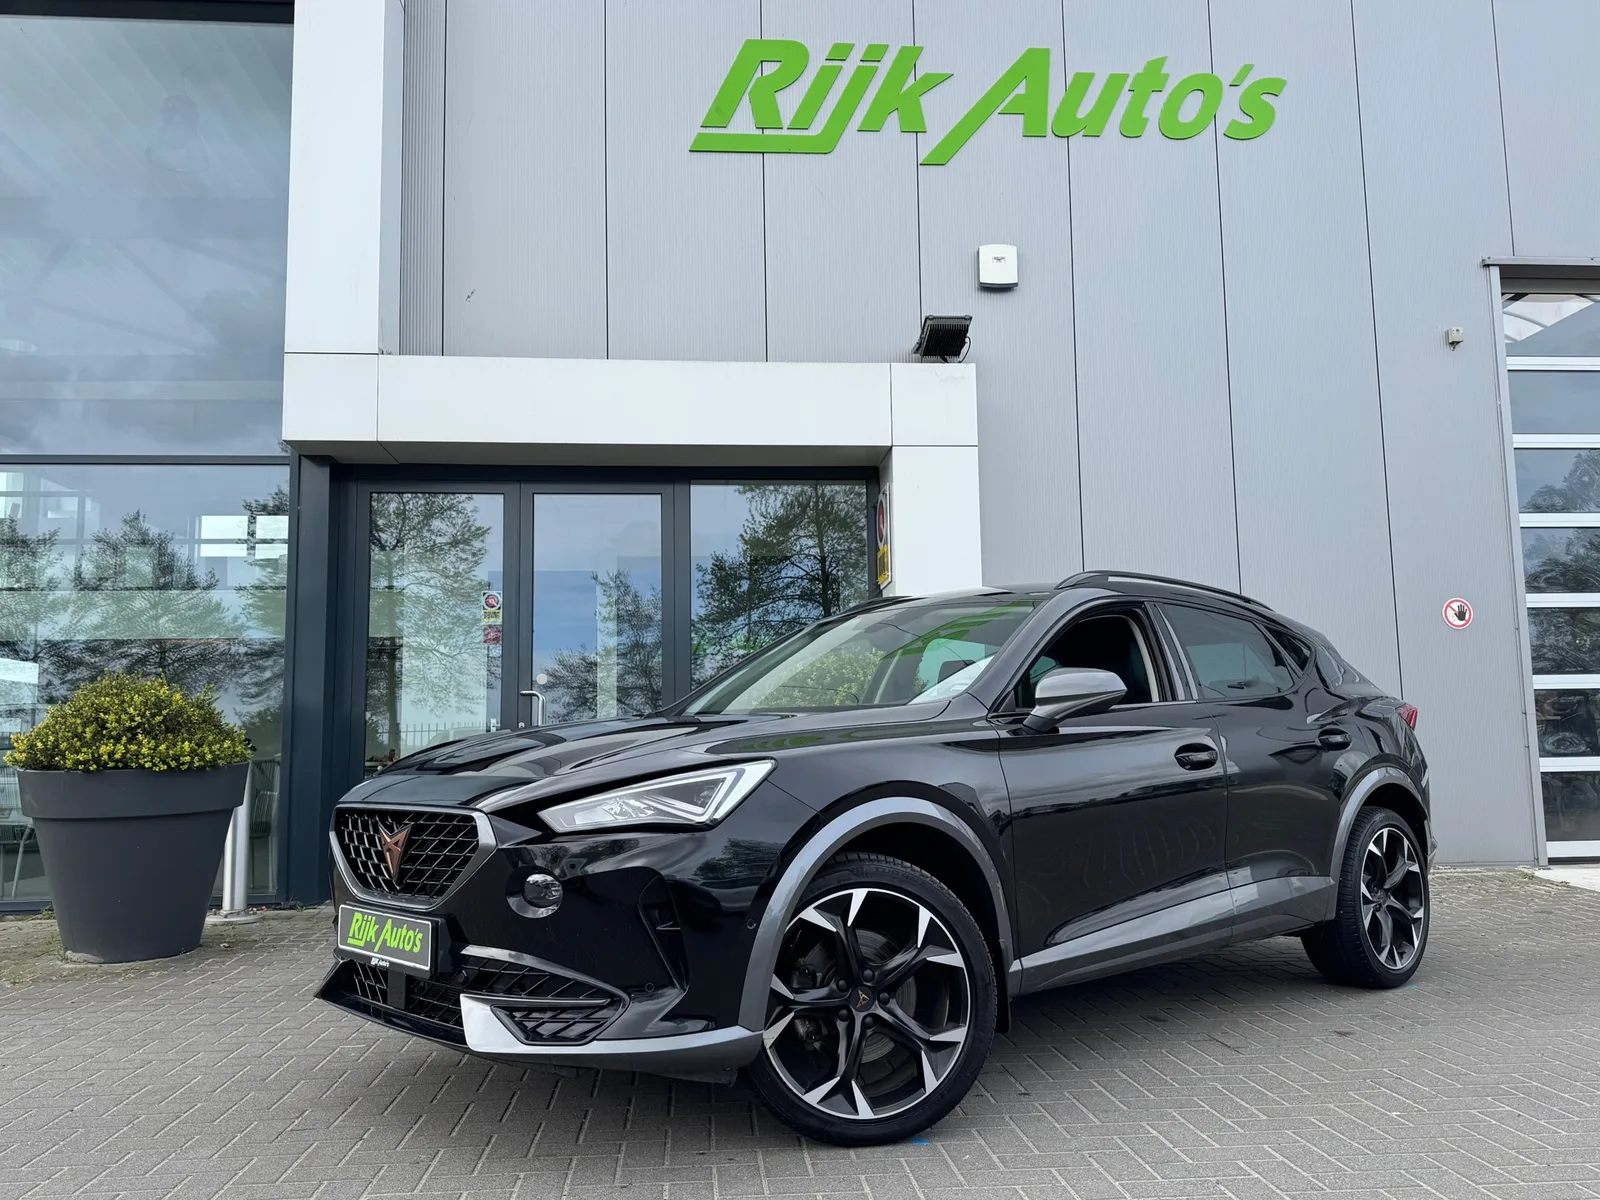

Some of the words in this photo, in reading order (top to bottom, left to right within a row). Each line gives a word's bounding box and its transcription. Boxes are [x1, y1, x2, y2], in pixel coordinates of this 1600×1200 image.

[689, 39, 952, 154] Rijk
[919, 47, 1286, 165] Auto's
[347, 912, 379, 947] Rijk
[373, 918, 423, 953] Auto's
